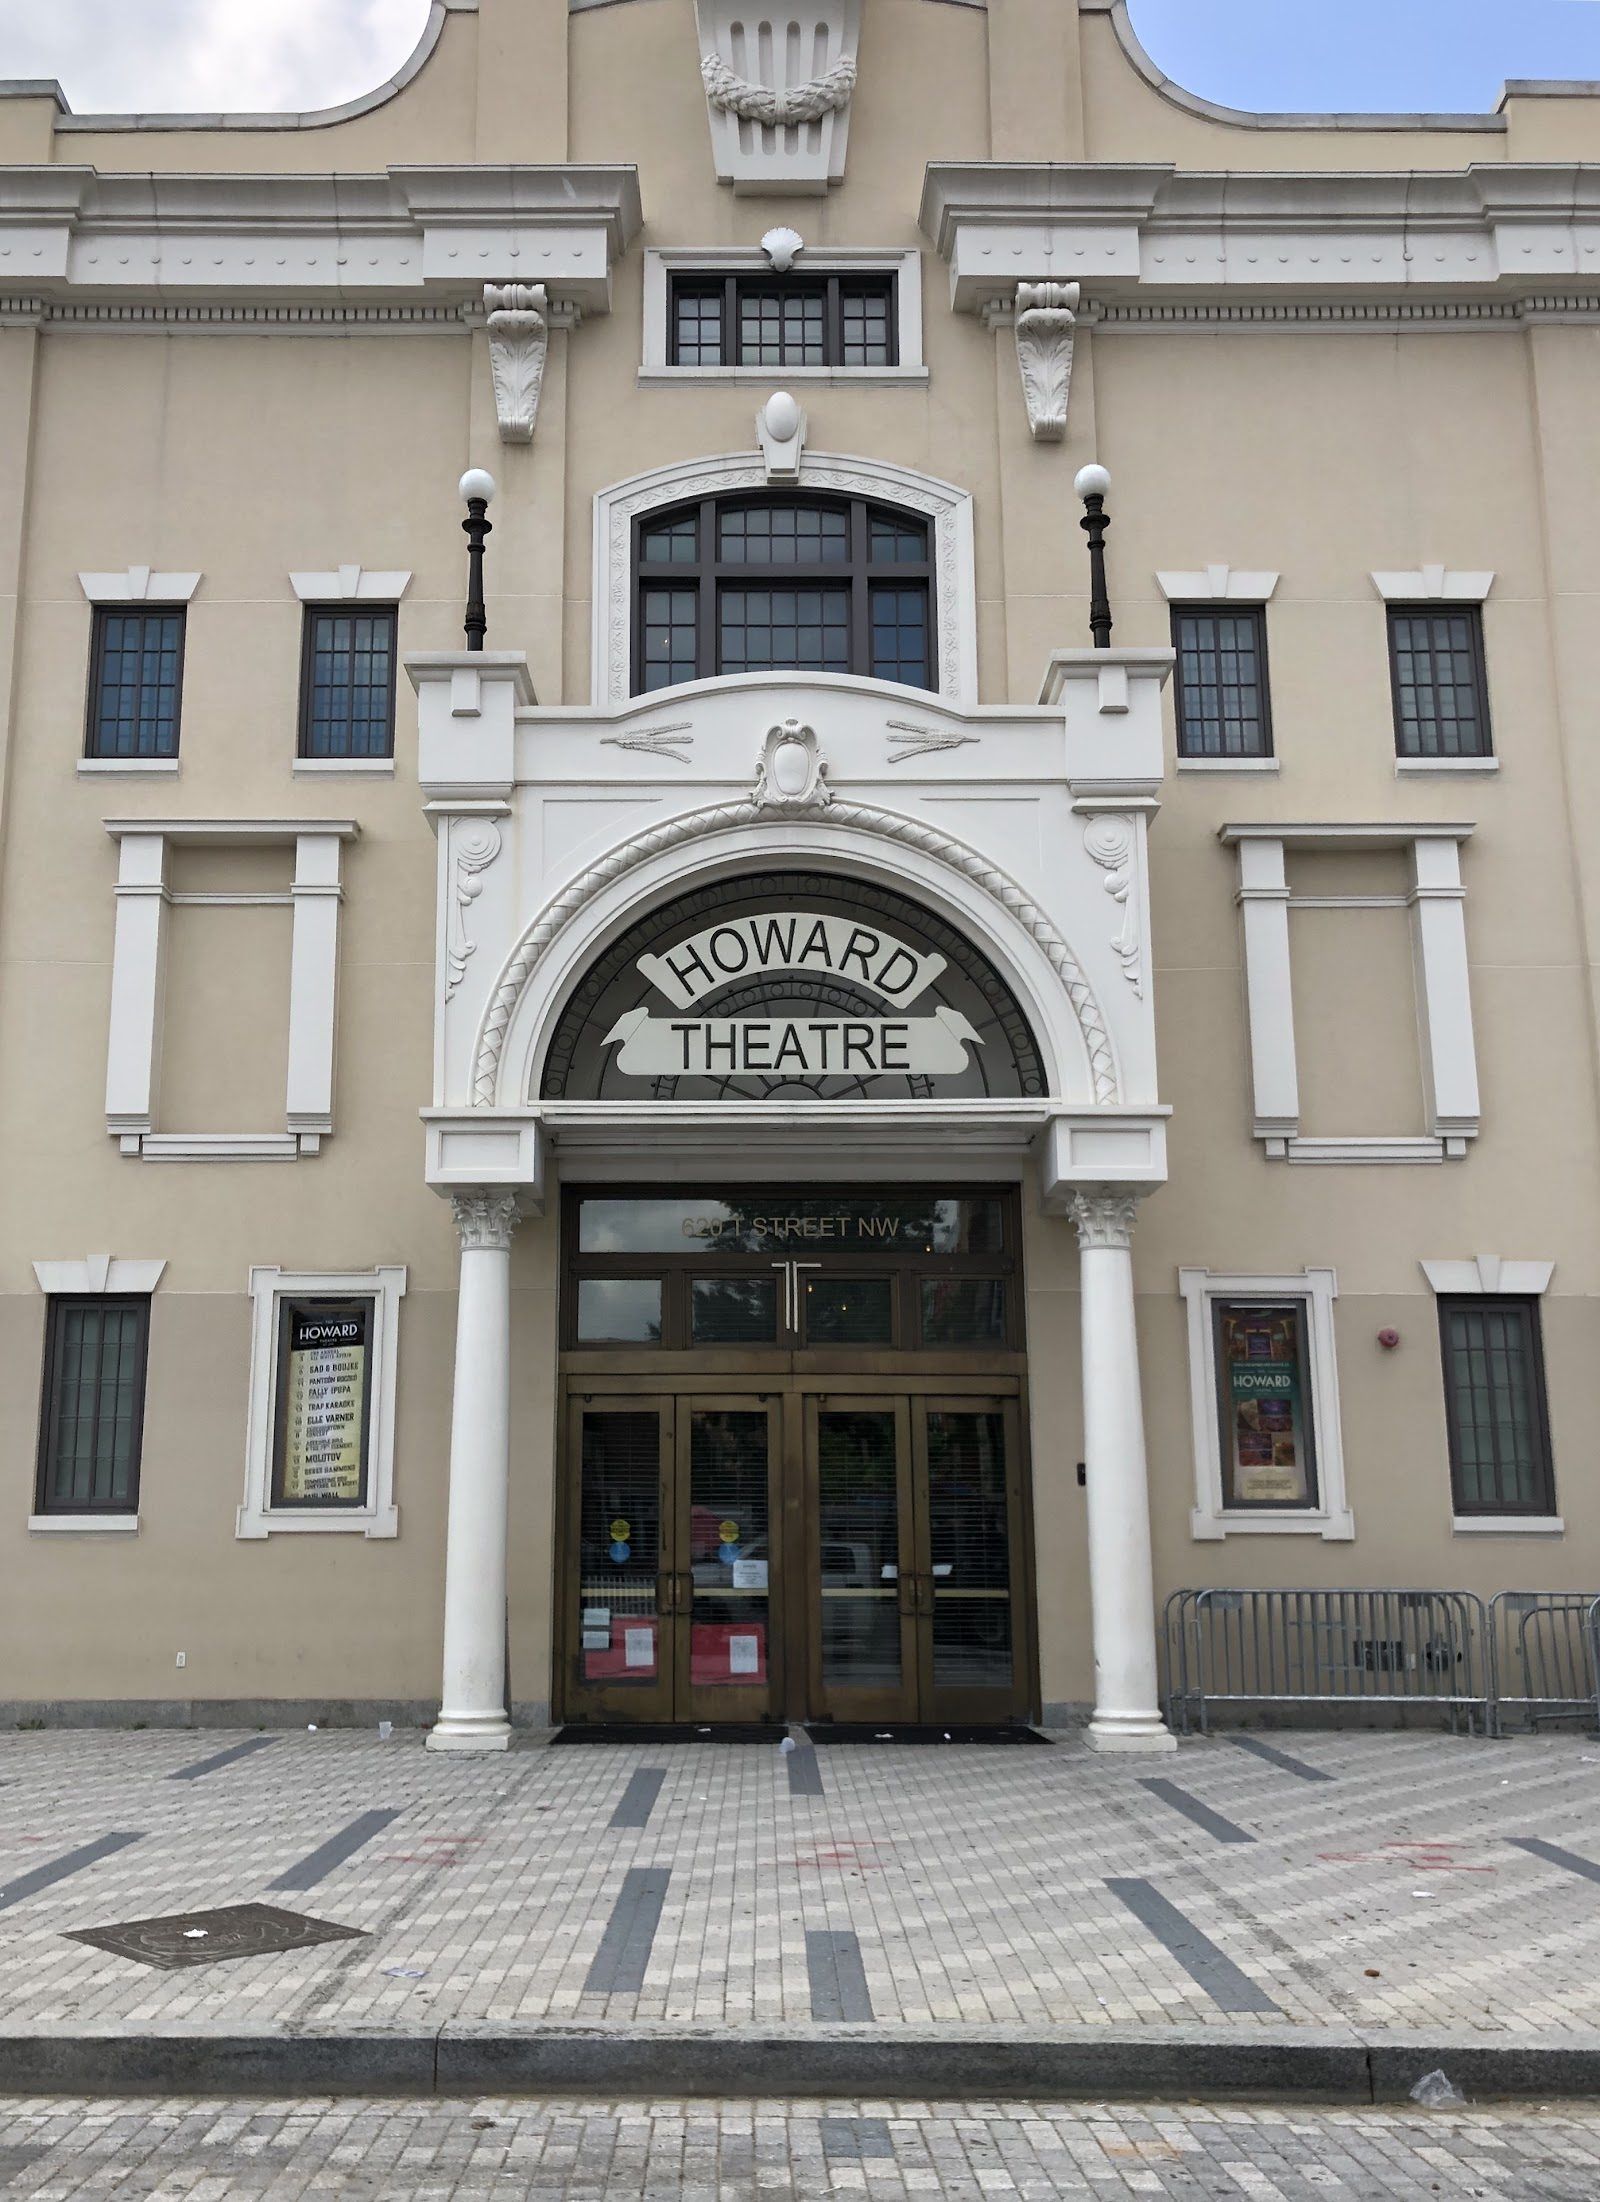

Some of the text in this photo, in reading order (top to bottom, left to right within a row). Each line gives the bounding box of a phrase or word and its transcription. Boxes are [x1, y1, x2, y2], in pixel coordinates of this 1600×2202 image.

[666, 918, 919, 997] HOWARD
[671, 1023, 911, 1070] THEATRE
[681, 1217, 899, 1237] 620 T STREET NW
[300, 1324, 358, 1340] HOWARD
[1233, 1375, 1291, 1388] HOWARD
[308, 1402, 324, 1411] TRAP
[325, 1399, 355, 1409] KARAOKE
[307, 1415, 323, 1425] ELLE
[325, 1412, 354, 1423] VARNER
[305, 1452, 341, 1463] MOLOTOV
